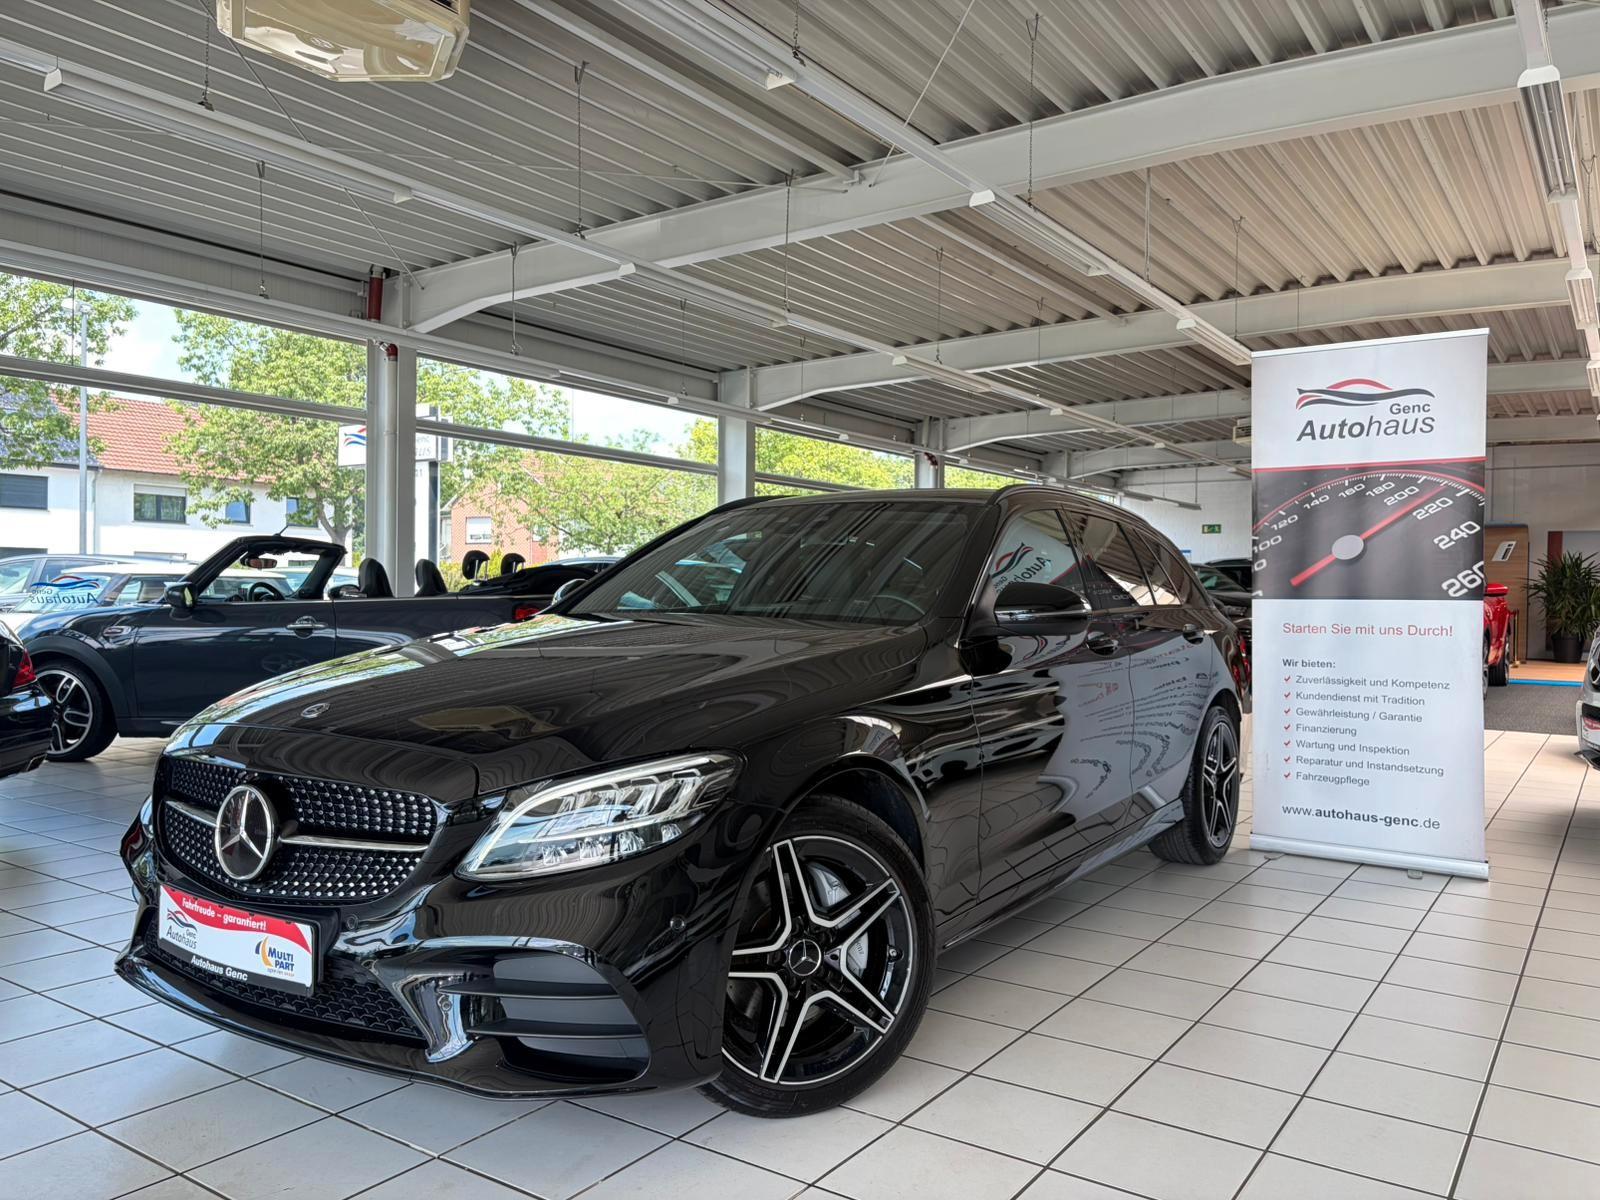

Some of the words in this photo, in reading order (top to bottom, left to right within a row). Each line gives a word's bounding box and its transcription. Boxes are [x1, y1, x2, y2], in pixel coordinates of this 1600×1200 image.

[1389, 402, 1431, 415] Genc
[1296, 415, 1436, 442] Autohaus
[1339, 483, 1366, 498] 160
[1366, 481, 1395, 496] 180
[1384, 486, 1419, 506] 200
[1304, 494, 1330, 510] 140
[1412, 497, 1454, 520] 220
[1270, 514, 1298, 532] 120
[1434, 521, 1480, 550] 240
[1252, 558, 1267, 571] 0
[1282, 623, 1327, 634] Starten
[1331, 624, 1351, 634] Sie
[1355, 624, 1375, 635] mit
[1379, 626, 1403, 636] uns
[1408, 625, 1453, 636] Durch!
[1282, 659, 1298, 668] Wir
[1302, 659, 1335, 669] bieten:
[1296, 675, 1366, 687] Zuverlässigkeit
[1370, 678, 1388, 687] und
[1392, 679, 1450, 690] Kompetenz
[1296, 692, 1360, 703] Kundendienst
[1364, 694, 1379, 704] mit
[1382, 696, 1425, 706] Tradition
[1296, 707, 1369, 720] Gewährleistung
[1379, 711, 1422, 722] Garantie
[1296, 724, 1357, 737] Finanzierung
[1296, 740, 1335, 752] Wartung
[1338, 742, 1356, 752] und
[1359, 744, 1409, 756] Inspektion
[1296, 755, 1343, 768] Reparatur
[1346, 759, 1364, 769] und
[1367, 761, 1444, 776] Instandsetzung
[1296, 772, 1370, 786] Fahrzeugpflege
[1282, 805, 1440, 829] www.autohaus-genc.de
[182, 897, 216, 917] Fahrfreude
[223, 912, 266, 931] garantiert!
[166, 925, 197, 950] Autohaus
[186, 928, 196, 939] Genc
[268, 947, 294, 962] MULTI
[191, 956, 224, 975] Autohaus
[225, 966, 248, 981] Genc
[274, 960, 294, 972] PART
